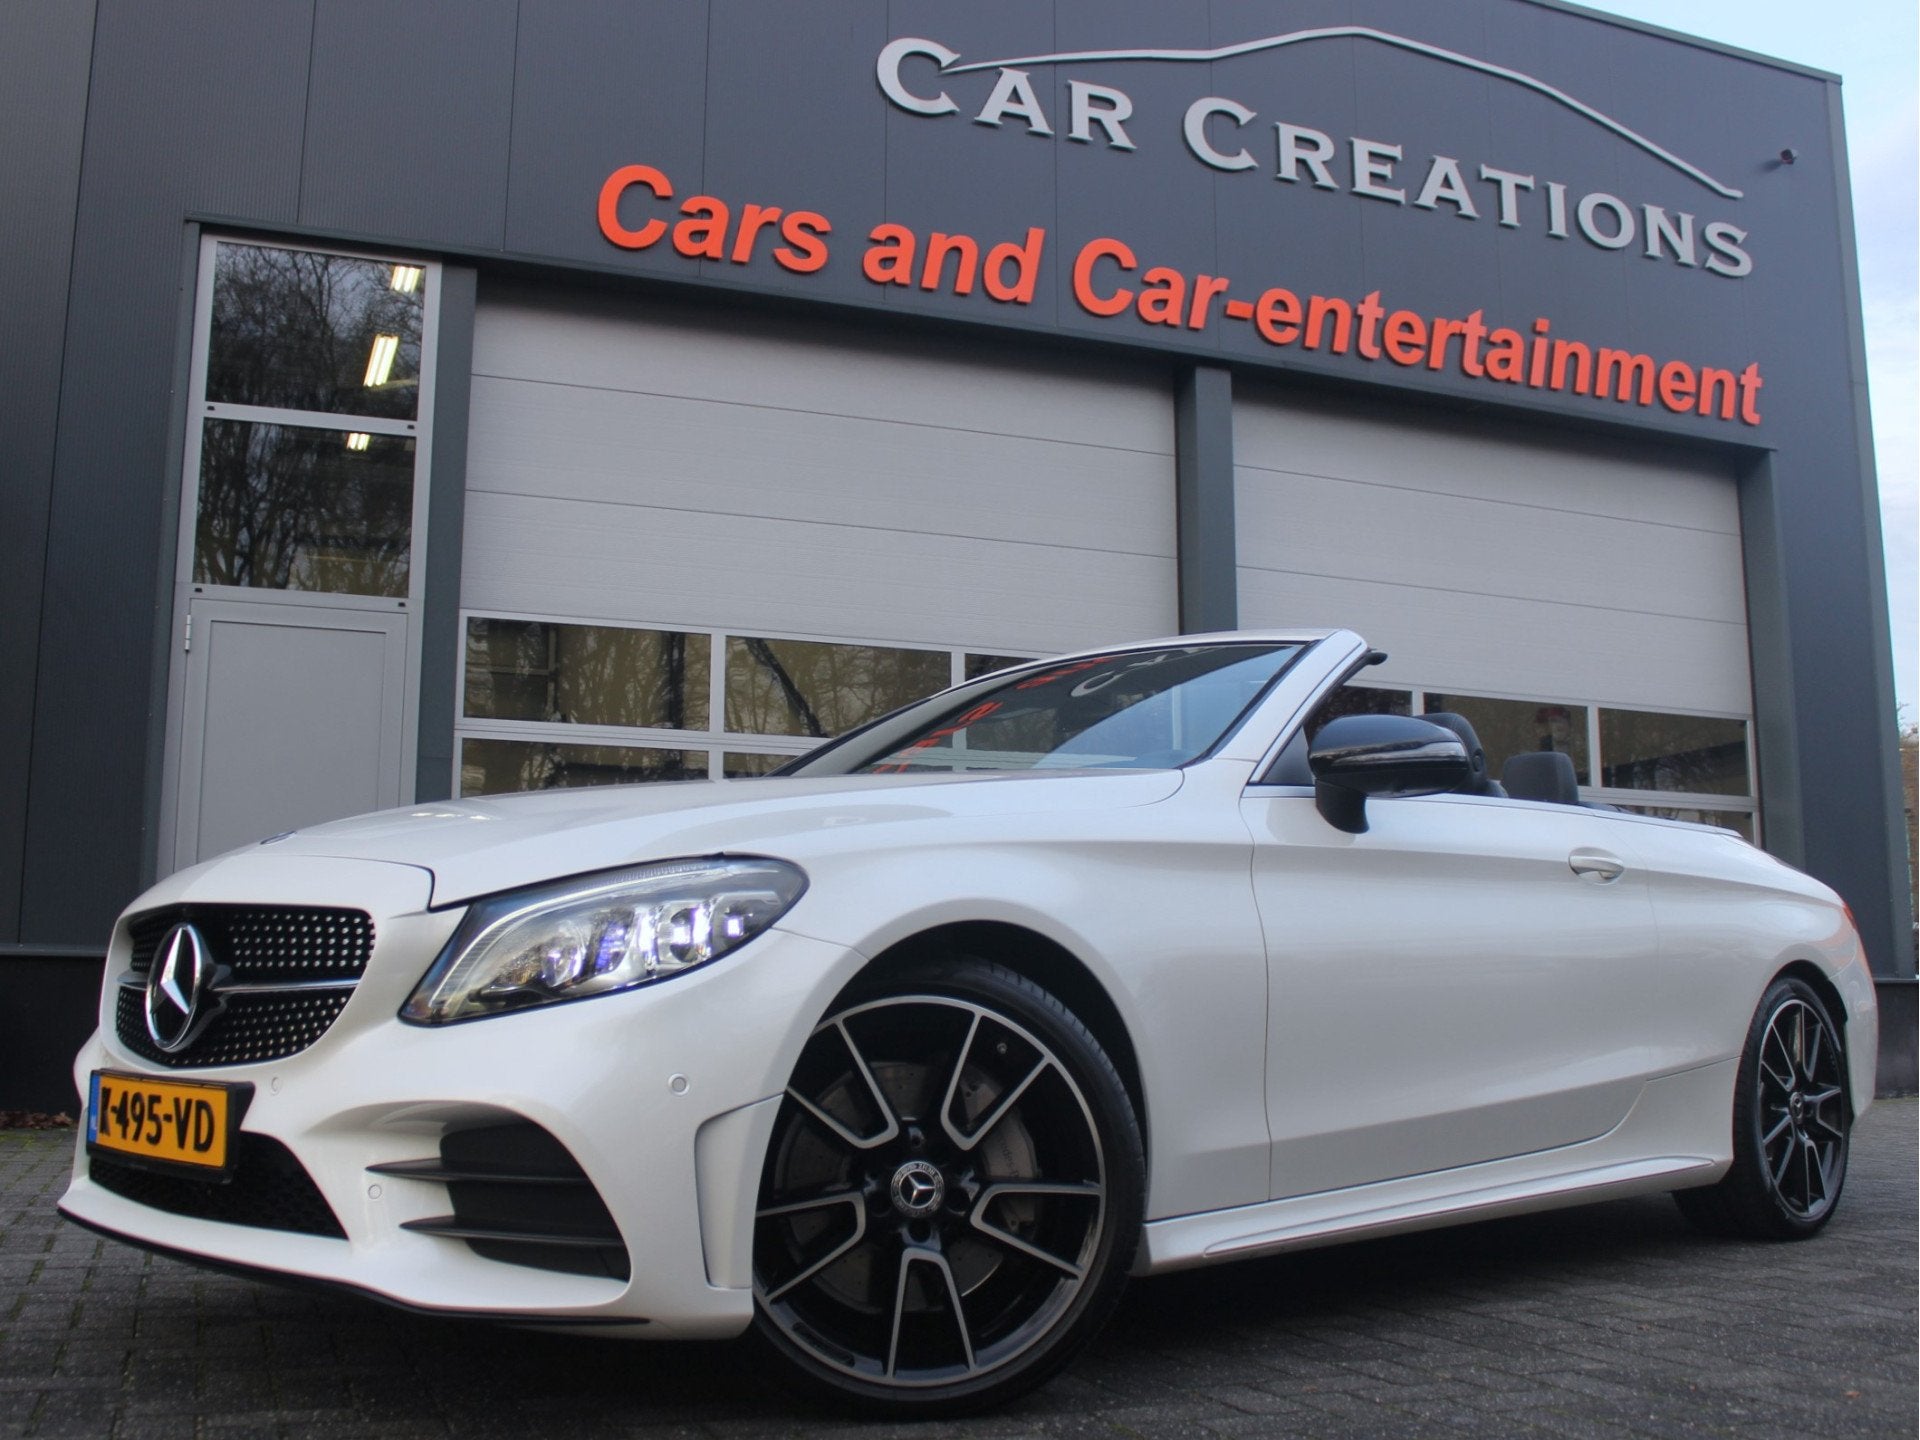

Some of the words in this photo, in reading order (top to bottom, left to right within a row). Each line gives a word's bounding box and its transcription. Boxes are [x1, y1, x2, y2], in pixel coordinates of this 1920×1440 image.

[876, 37, 1137, 151] CAR
[1183, 96, 1753, 277] CREATIONS
[597, 164, 832, 273] Cars
[862, 223, 1045, 305] and
[1073, 238, 1762, 425] Car-entertainment
